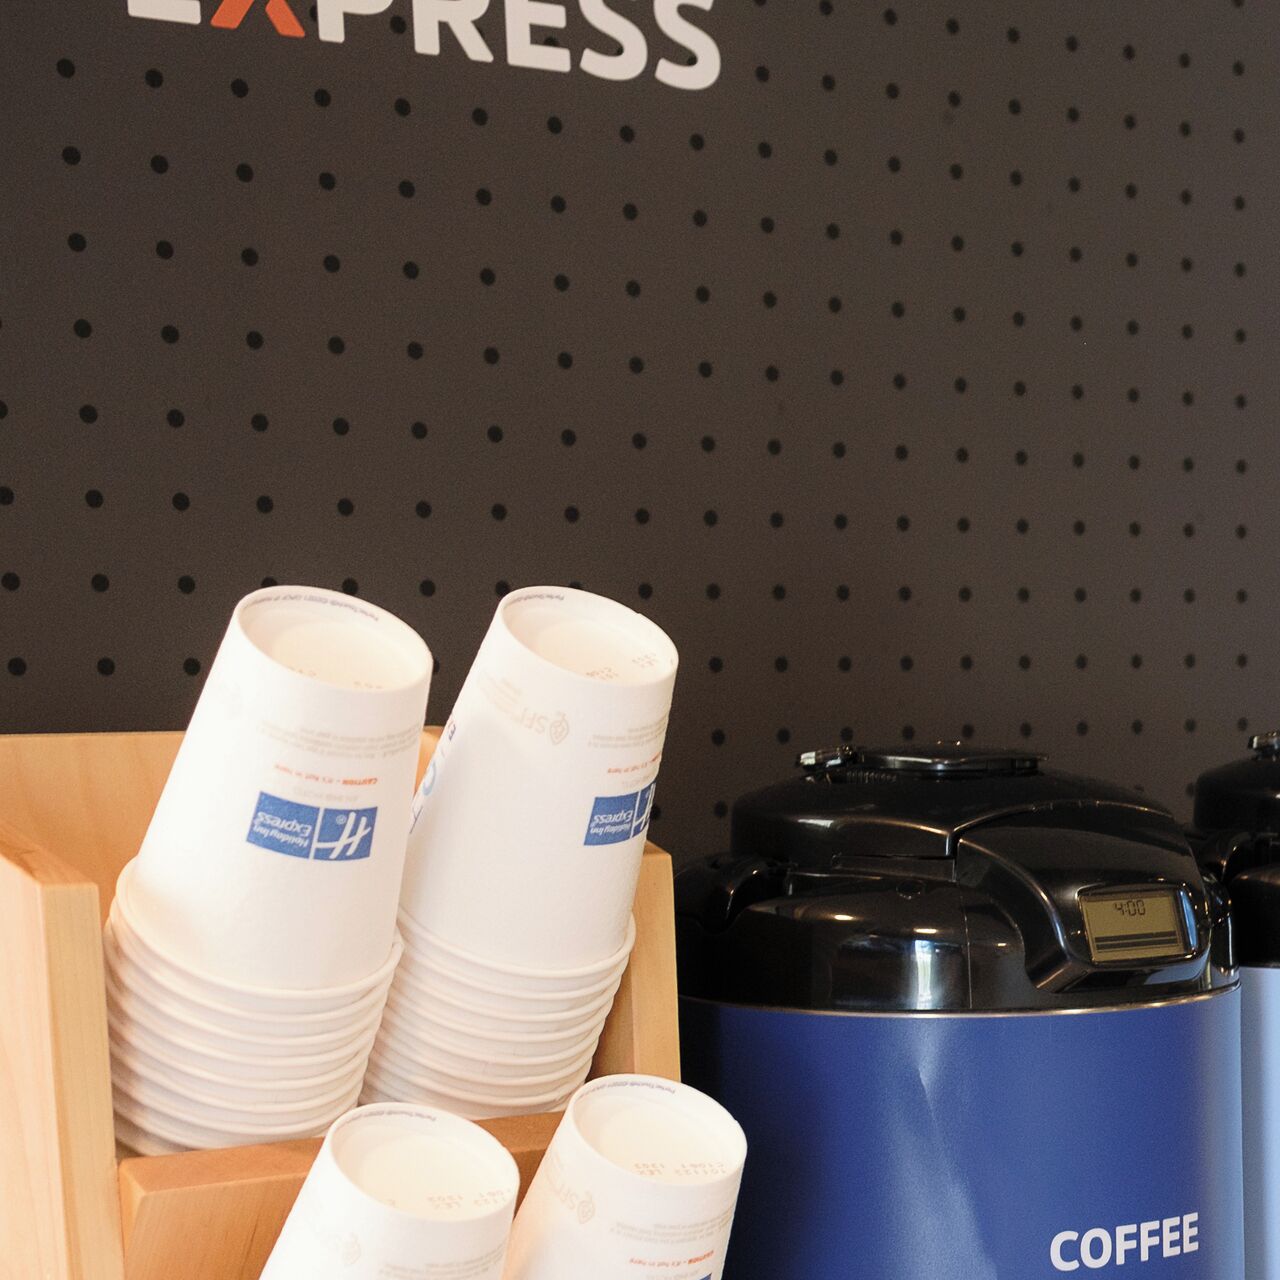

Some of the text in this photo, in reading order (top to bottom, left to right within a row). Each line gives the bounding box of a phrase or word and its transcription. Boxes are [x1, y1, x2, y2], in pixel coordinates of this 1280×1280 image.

[256, 811, 313, 837] Express
[593, 809, 634, 825] Express
[268, 826, 310, 848] Holiday
[1113, 899, 1147, 917] 4:00
[1050, 1212, 1199, 1272] COFFEE
